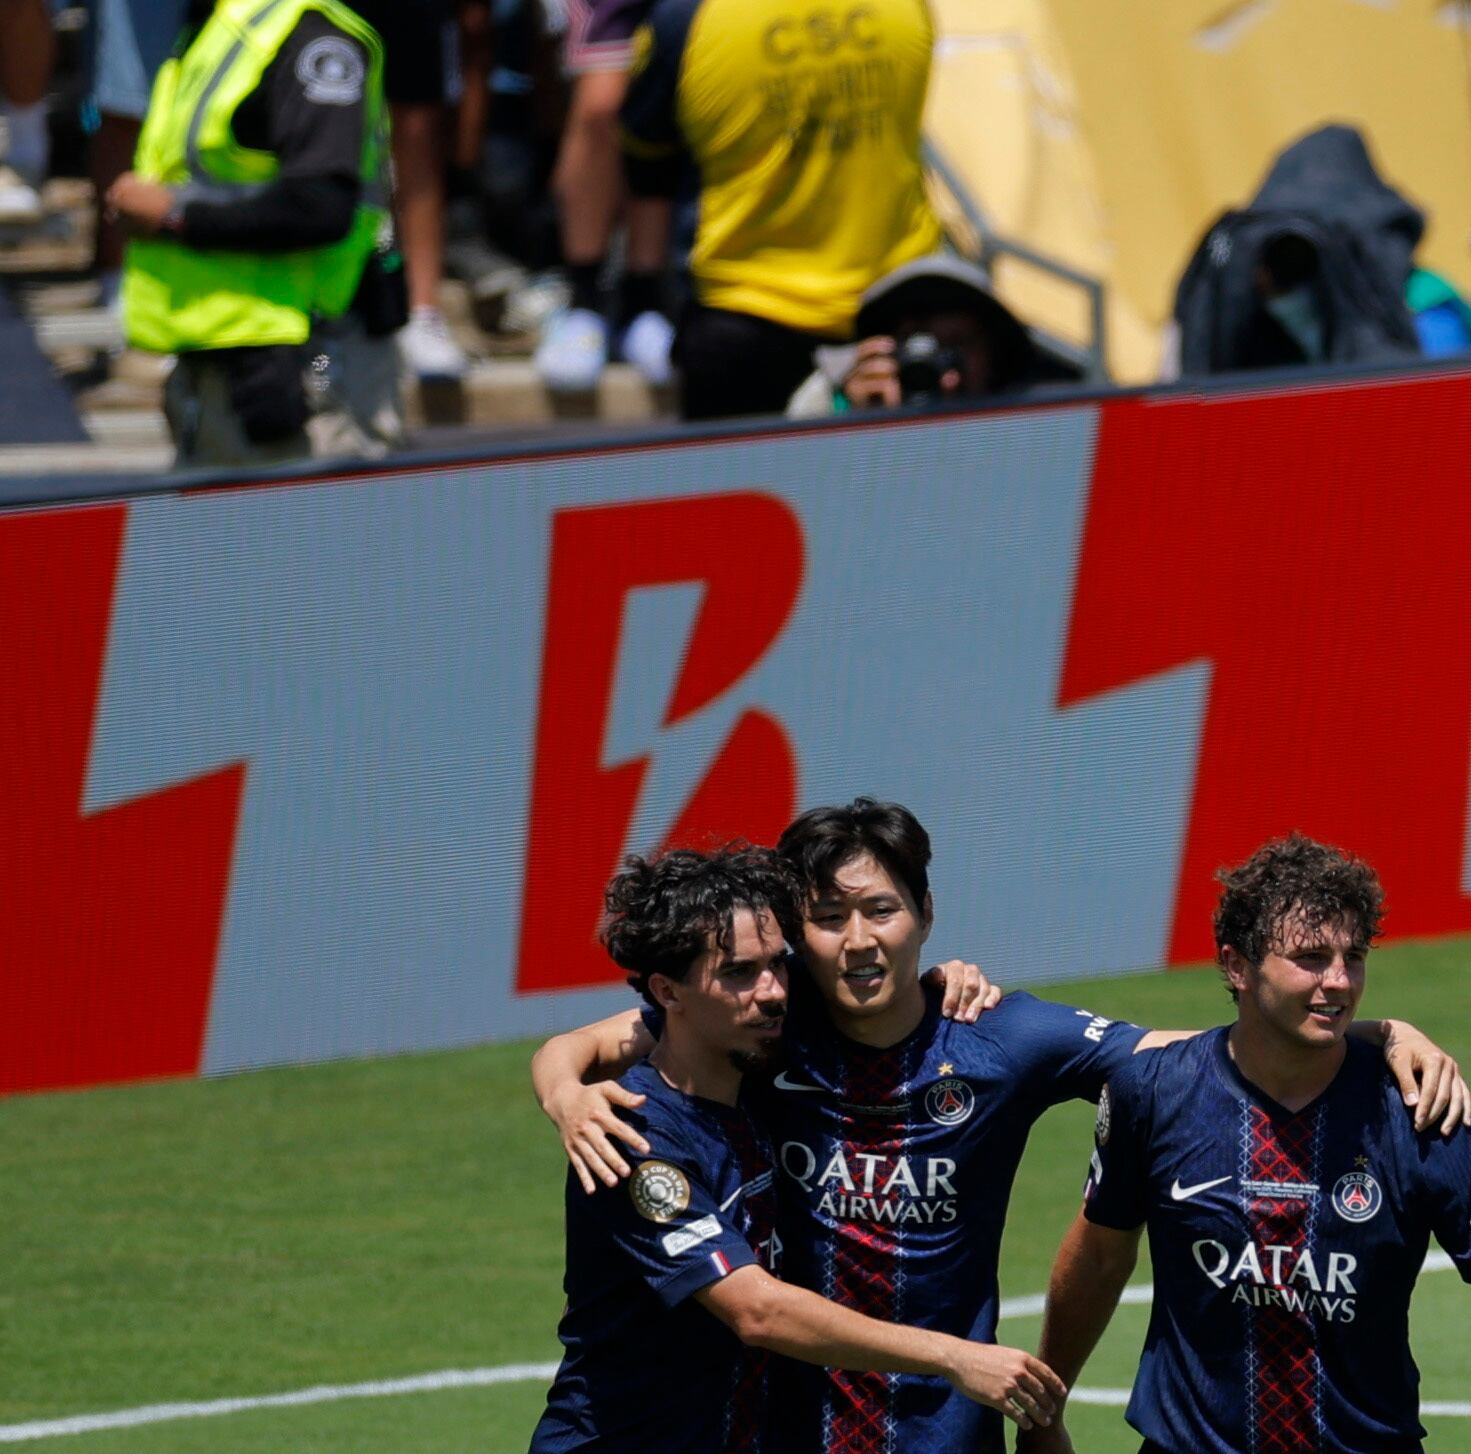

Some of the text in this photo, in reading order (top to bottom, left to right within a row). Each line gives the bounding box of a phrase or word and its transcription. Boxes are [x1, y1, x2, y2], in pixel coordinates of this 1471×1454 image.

[764, 9, 879, 63] CSC
[780, 1140, 958, 1198] QATAR
[1341, 1174, 1376, 1188] PARIS
[815, 1191, 957, 1224] AIRWAYS
[1191, 1239, 1358, 1295] QATAR
[1231, 1284, 1357, 1324] AIRWAYS
